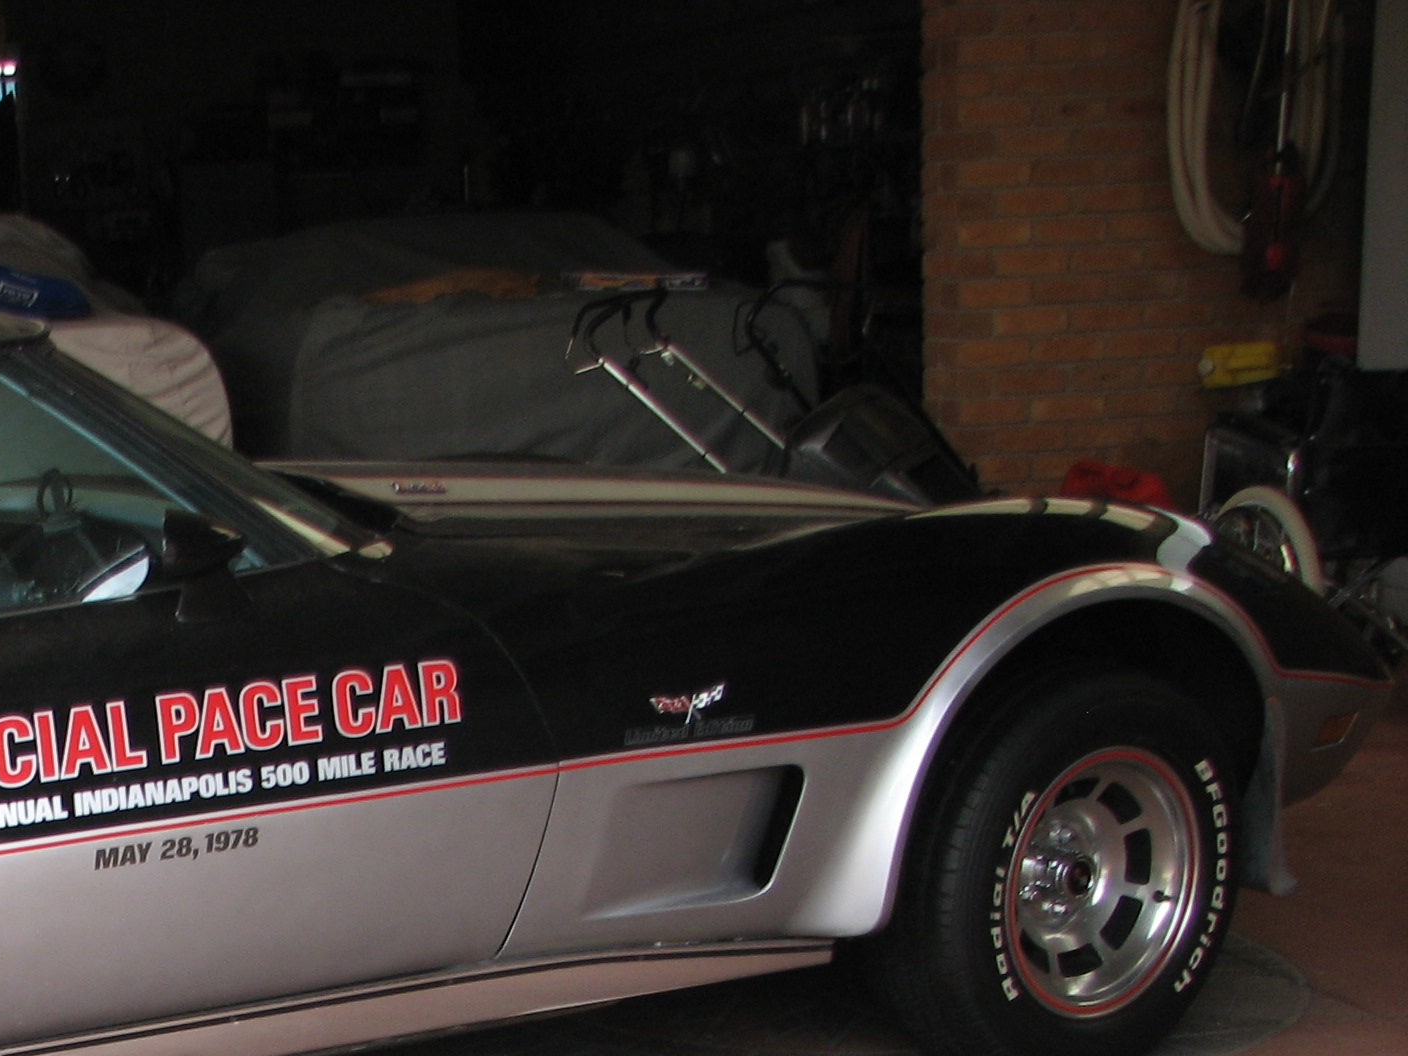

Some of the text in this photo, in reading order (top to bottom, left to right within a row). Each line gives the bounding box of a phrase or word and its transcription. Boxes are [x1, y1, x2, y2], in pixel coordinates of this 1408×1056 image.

[154, 675, 324, 765] PACE
[331, 659, 463, 740] CAR
[74, 769, 254, 818] INDIANAPOLIS
[261, 763, 311, 789] 500
[318, 754, 377, 783] MILE
[383, 742, 447, 772] RACE
[93, 842, 152, 871] MAY
